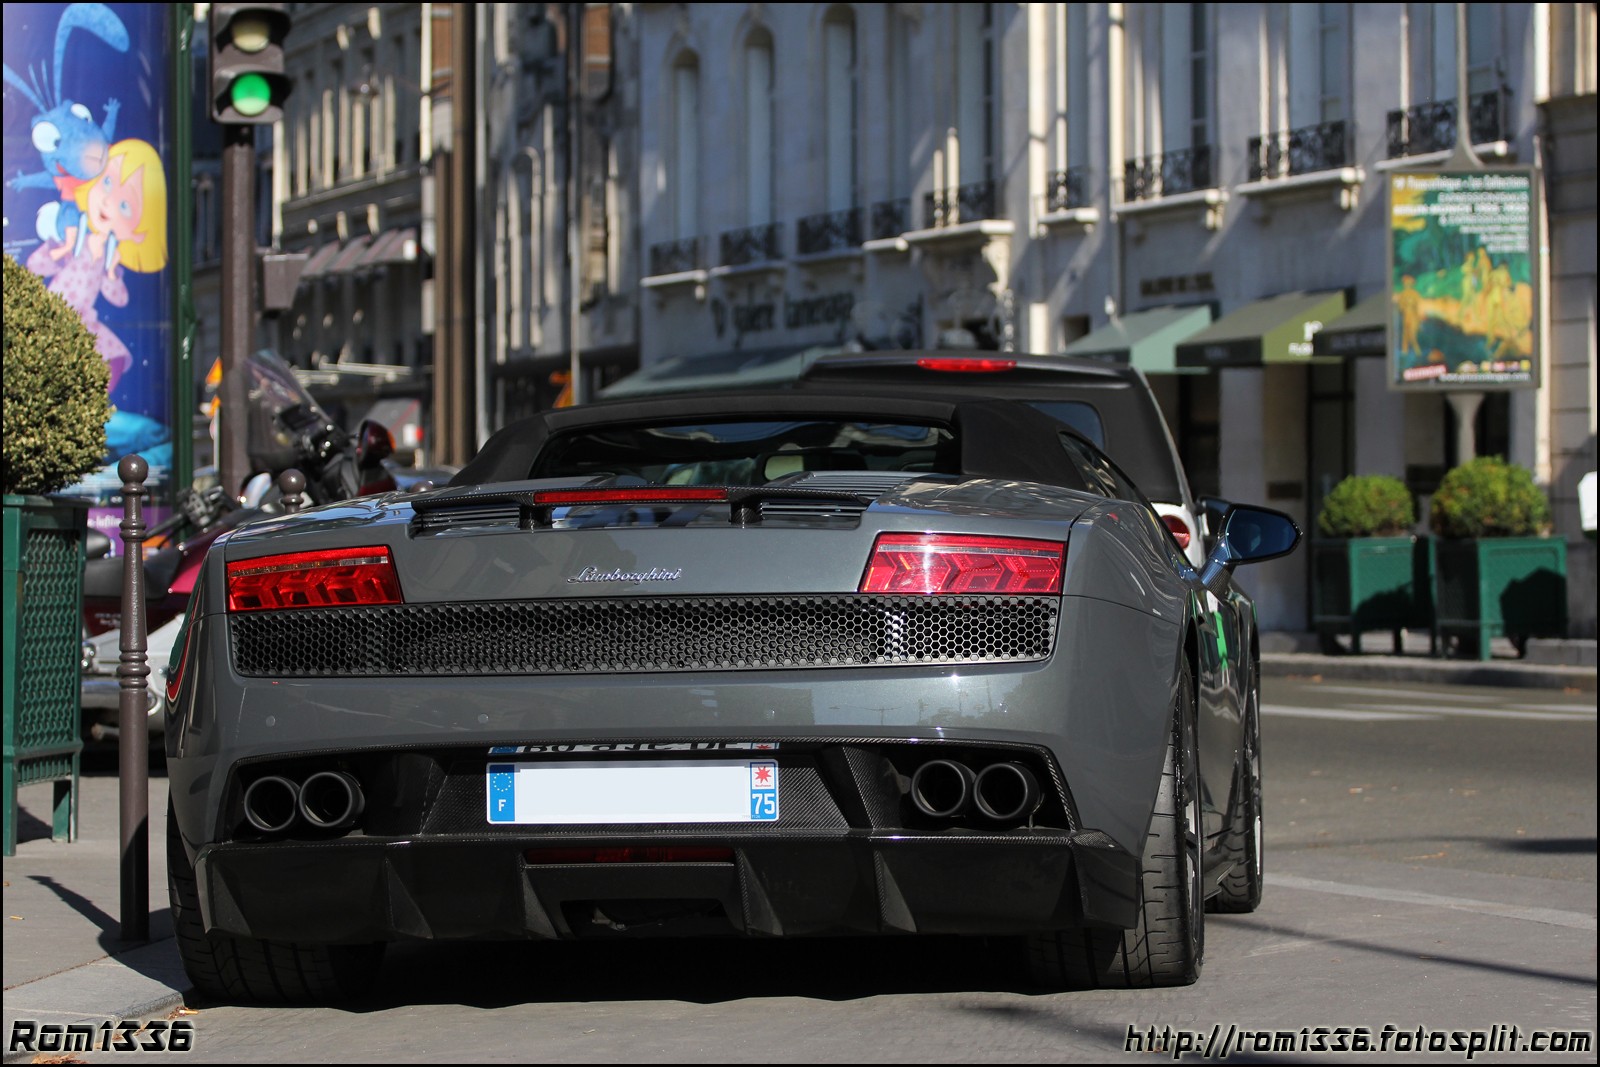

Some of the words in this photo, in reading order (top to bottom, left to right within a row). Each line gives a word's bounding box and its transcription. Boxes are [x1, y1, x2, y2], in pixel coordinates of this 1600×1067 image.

[567, 566, 681, 585] Lamborghini
[498, 799, 506, 811] F
[752, 793, 775, 815] 75
